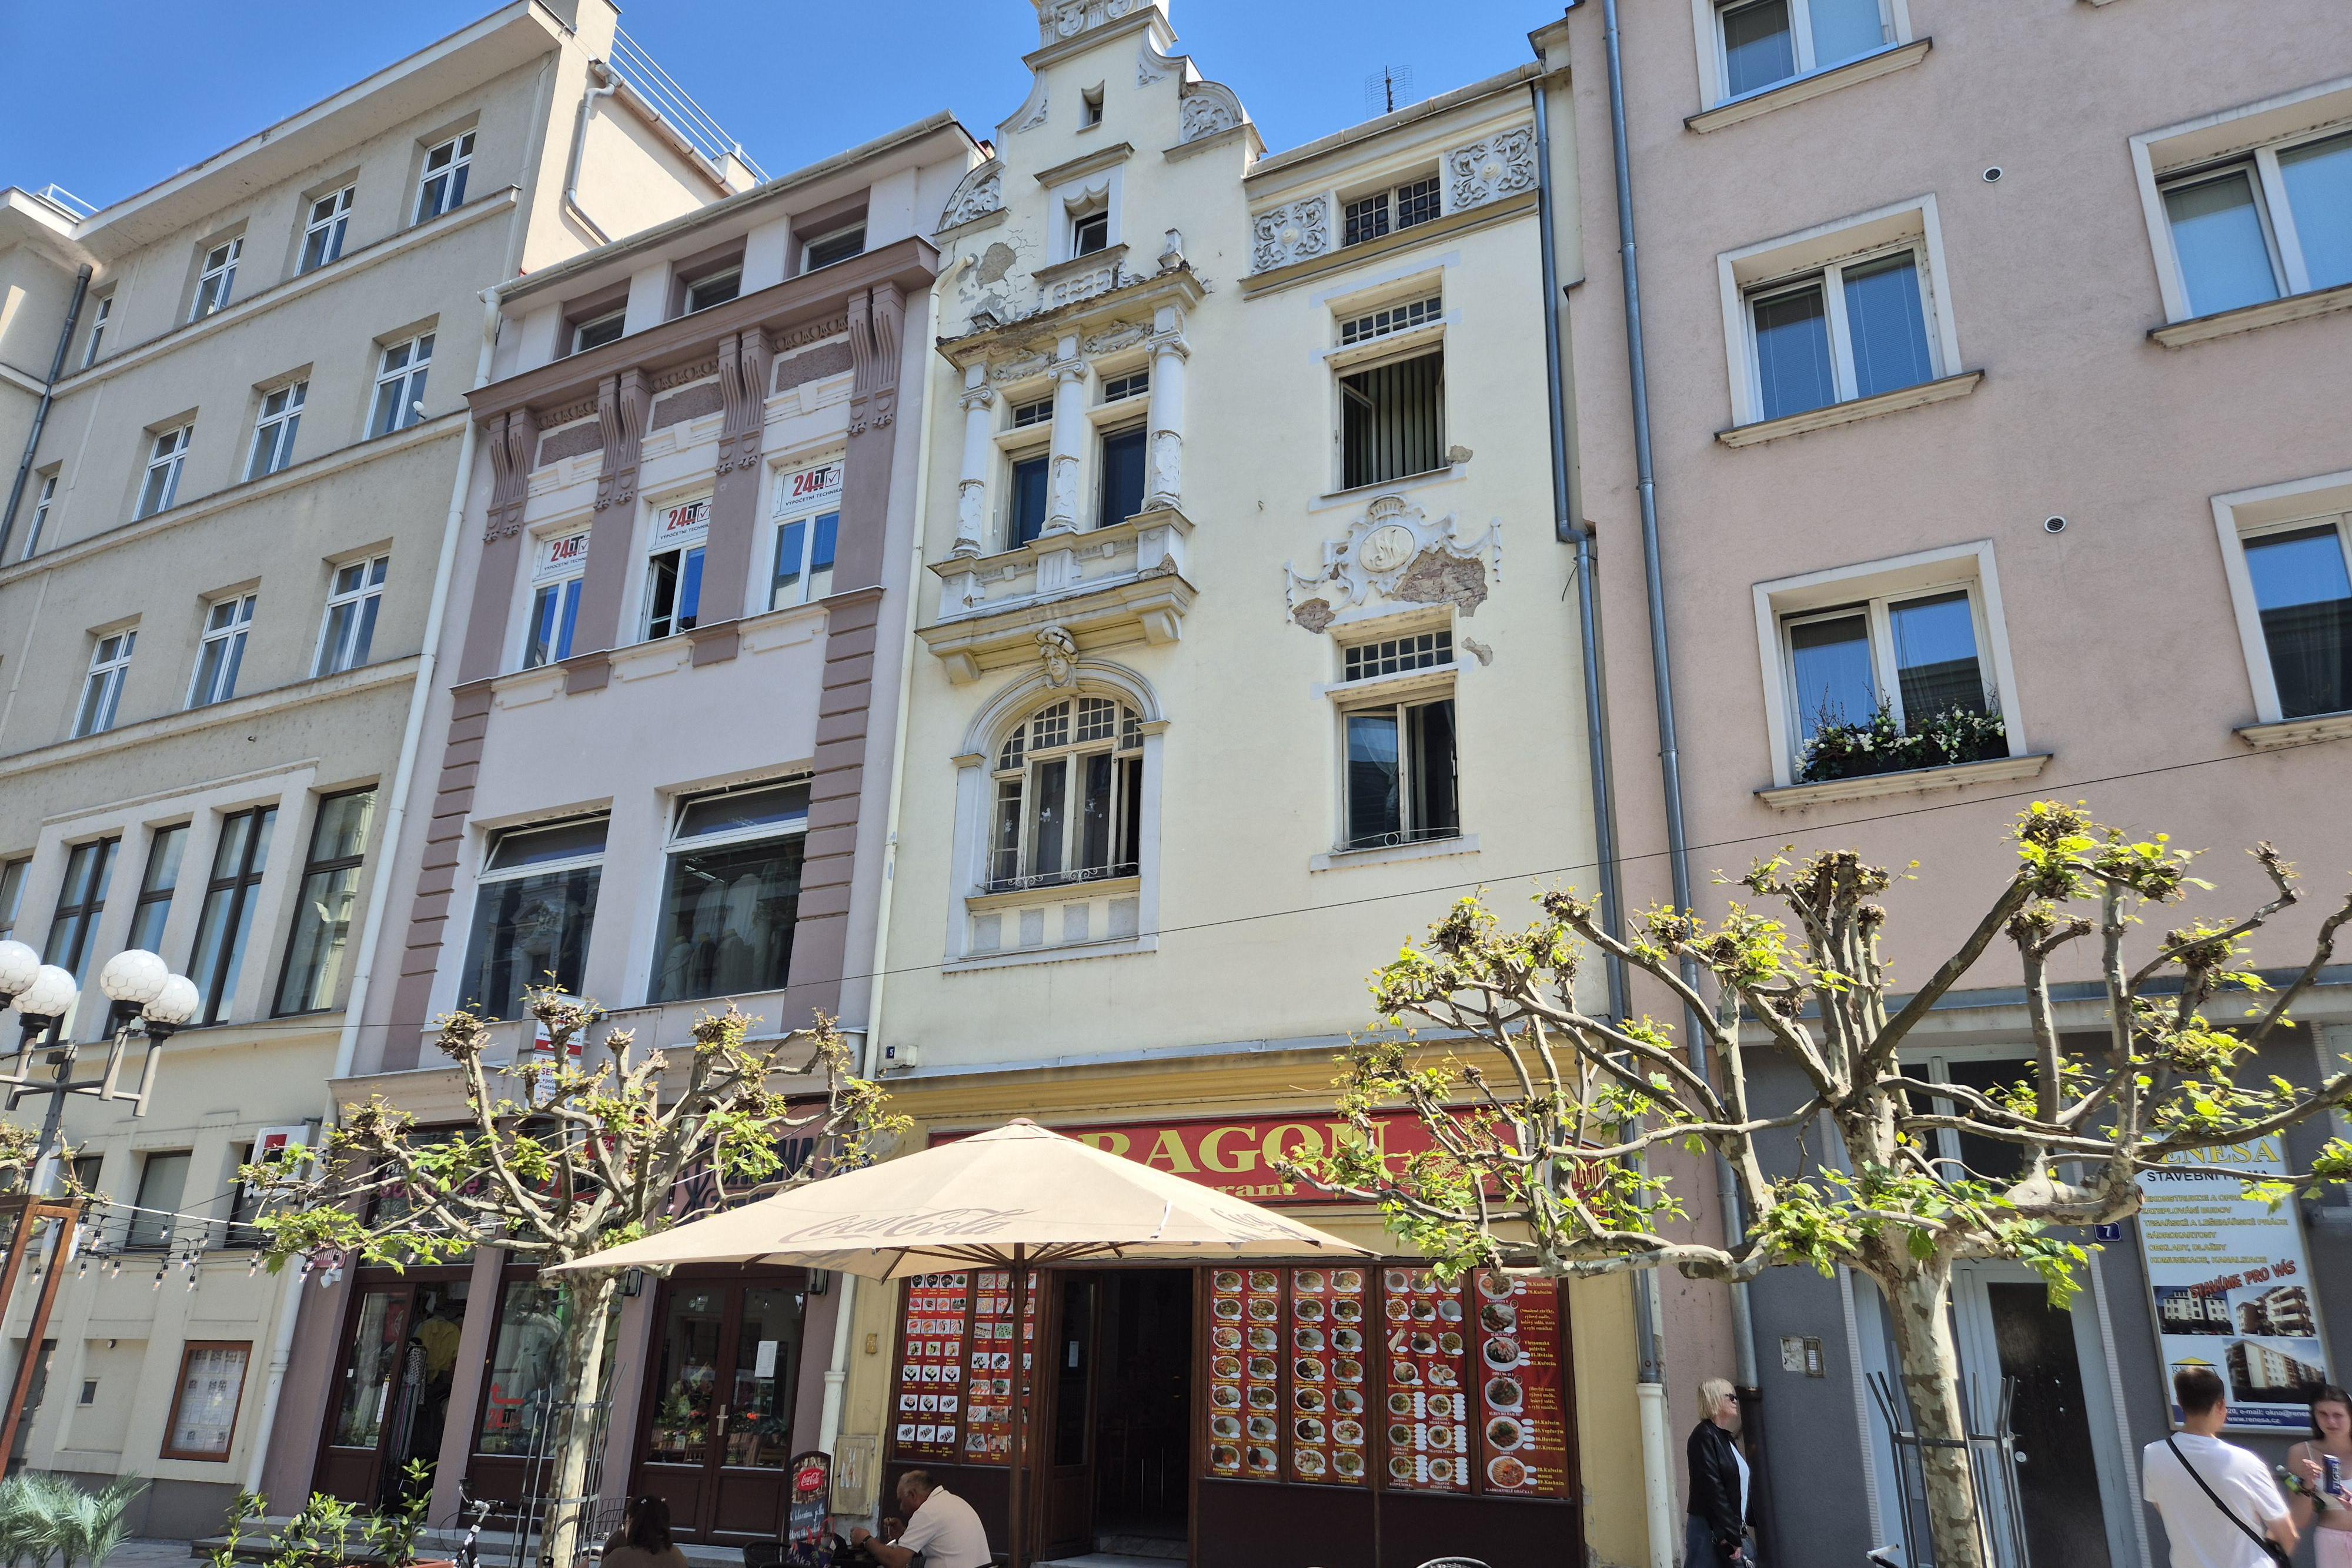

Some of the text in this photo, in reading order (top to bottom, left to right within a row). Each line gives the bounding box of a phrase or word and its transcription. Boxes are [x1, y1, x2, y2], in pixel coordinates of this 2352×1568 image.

[816, 487, 843, 498] TECHNIKA
[689, 523, 709, 532] TECHNIK
[1077, 1121, 1391, 1173] RAGON
[2159, 1139, 2281, 1164] ENESA
[778, 1208, 1040, 1243] Coca-Cola
[2257, 1218, 2288, 1226] PRÁCE
[2103, 1226, 2111, 1237] 7
[2192, 1242, 2226, 1251] DLAŽBY
[2190, 1259, 2296, 1299] STAVÍME PRO VÁS
[2265, 1409, 2310, 1417] okna@renes
[801, 1472, 820, 1487] Coca-Cola
